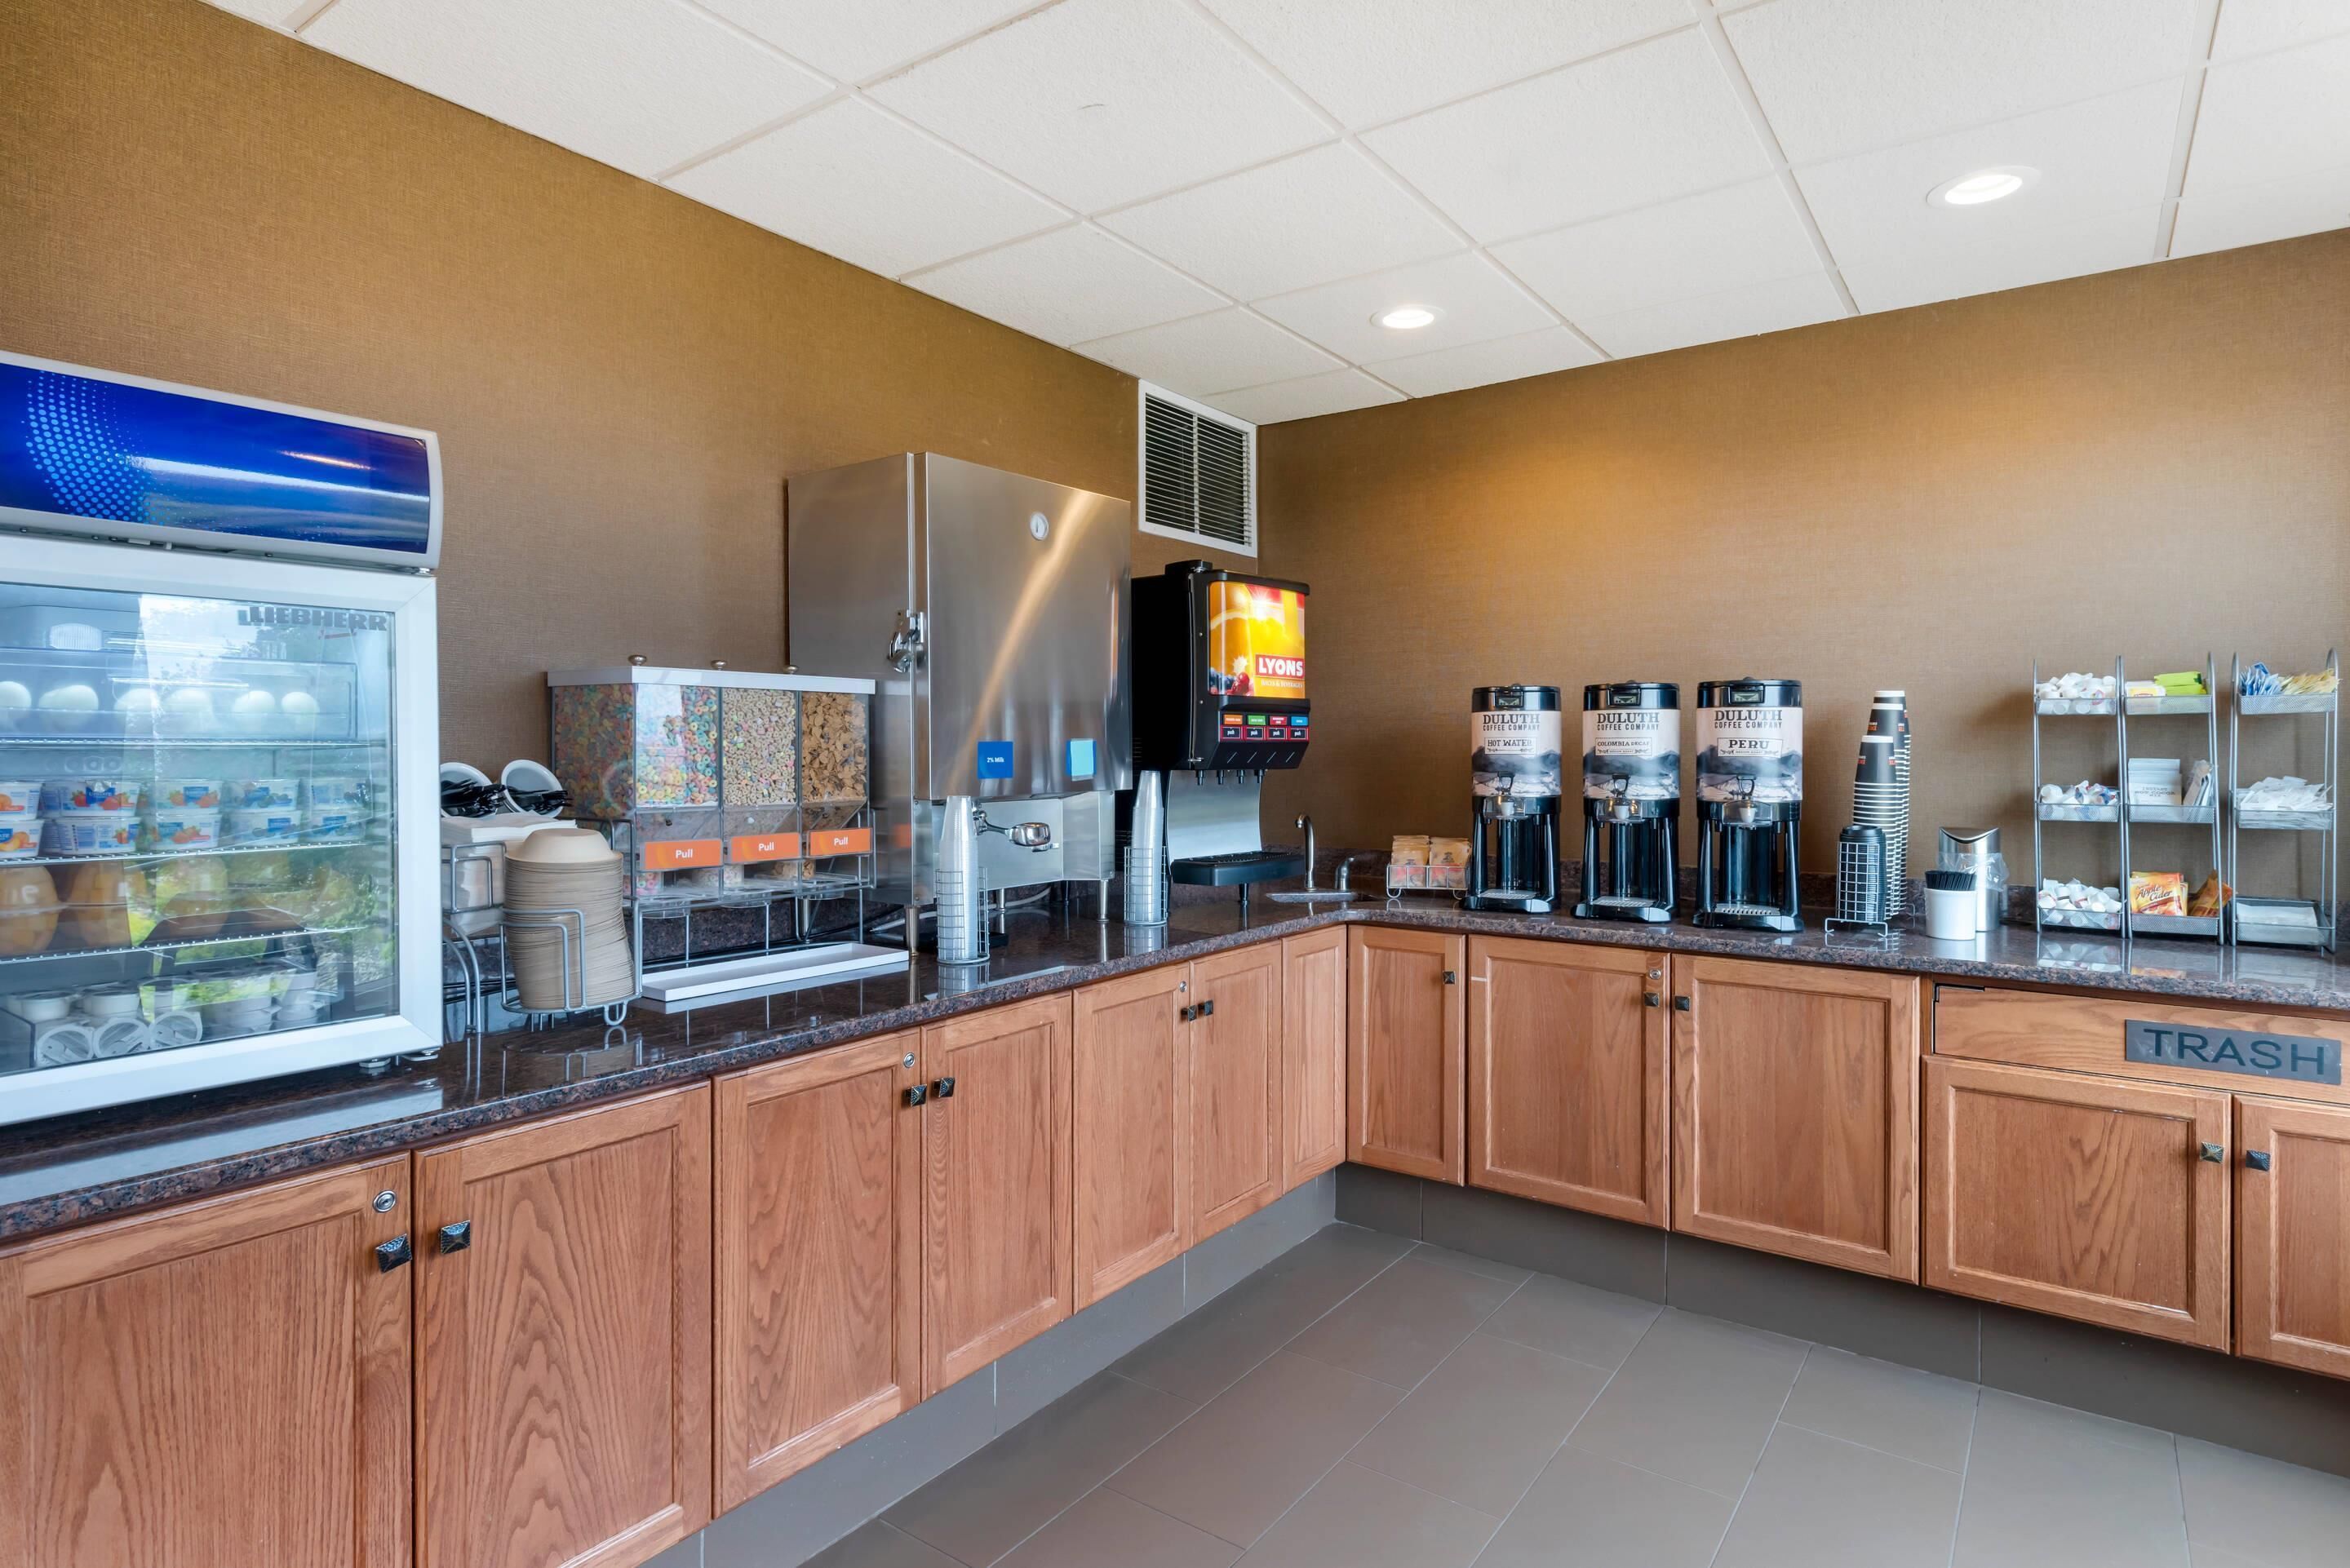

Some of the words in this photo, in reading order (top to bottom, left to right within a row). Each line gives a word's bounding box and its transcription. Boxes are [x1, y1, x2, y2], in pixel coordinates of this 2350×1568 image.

[248, 606, 387, 631] LIEBHERR
[1258, 657, 1303, 676] LYONS
[1483, 714, 1541, 724] DULUTH
[1597, 712, 1660, 724] DULUTH
[1714, 710, 1783, 721] DULUTH
[1488, 739, 1501, 747] HOT
[1728, 739, 1770, 750] PERU
[758, 841, 774, 852] Pull
[833, 836, 849, 846] Pull
[675, 848, 693, 858] Pull
[2135, 884, 2162, 900] Apple
[2149, 890, 2173, 901] Cider
[2143, 1028, 2325, 1075] TRASH
